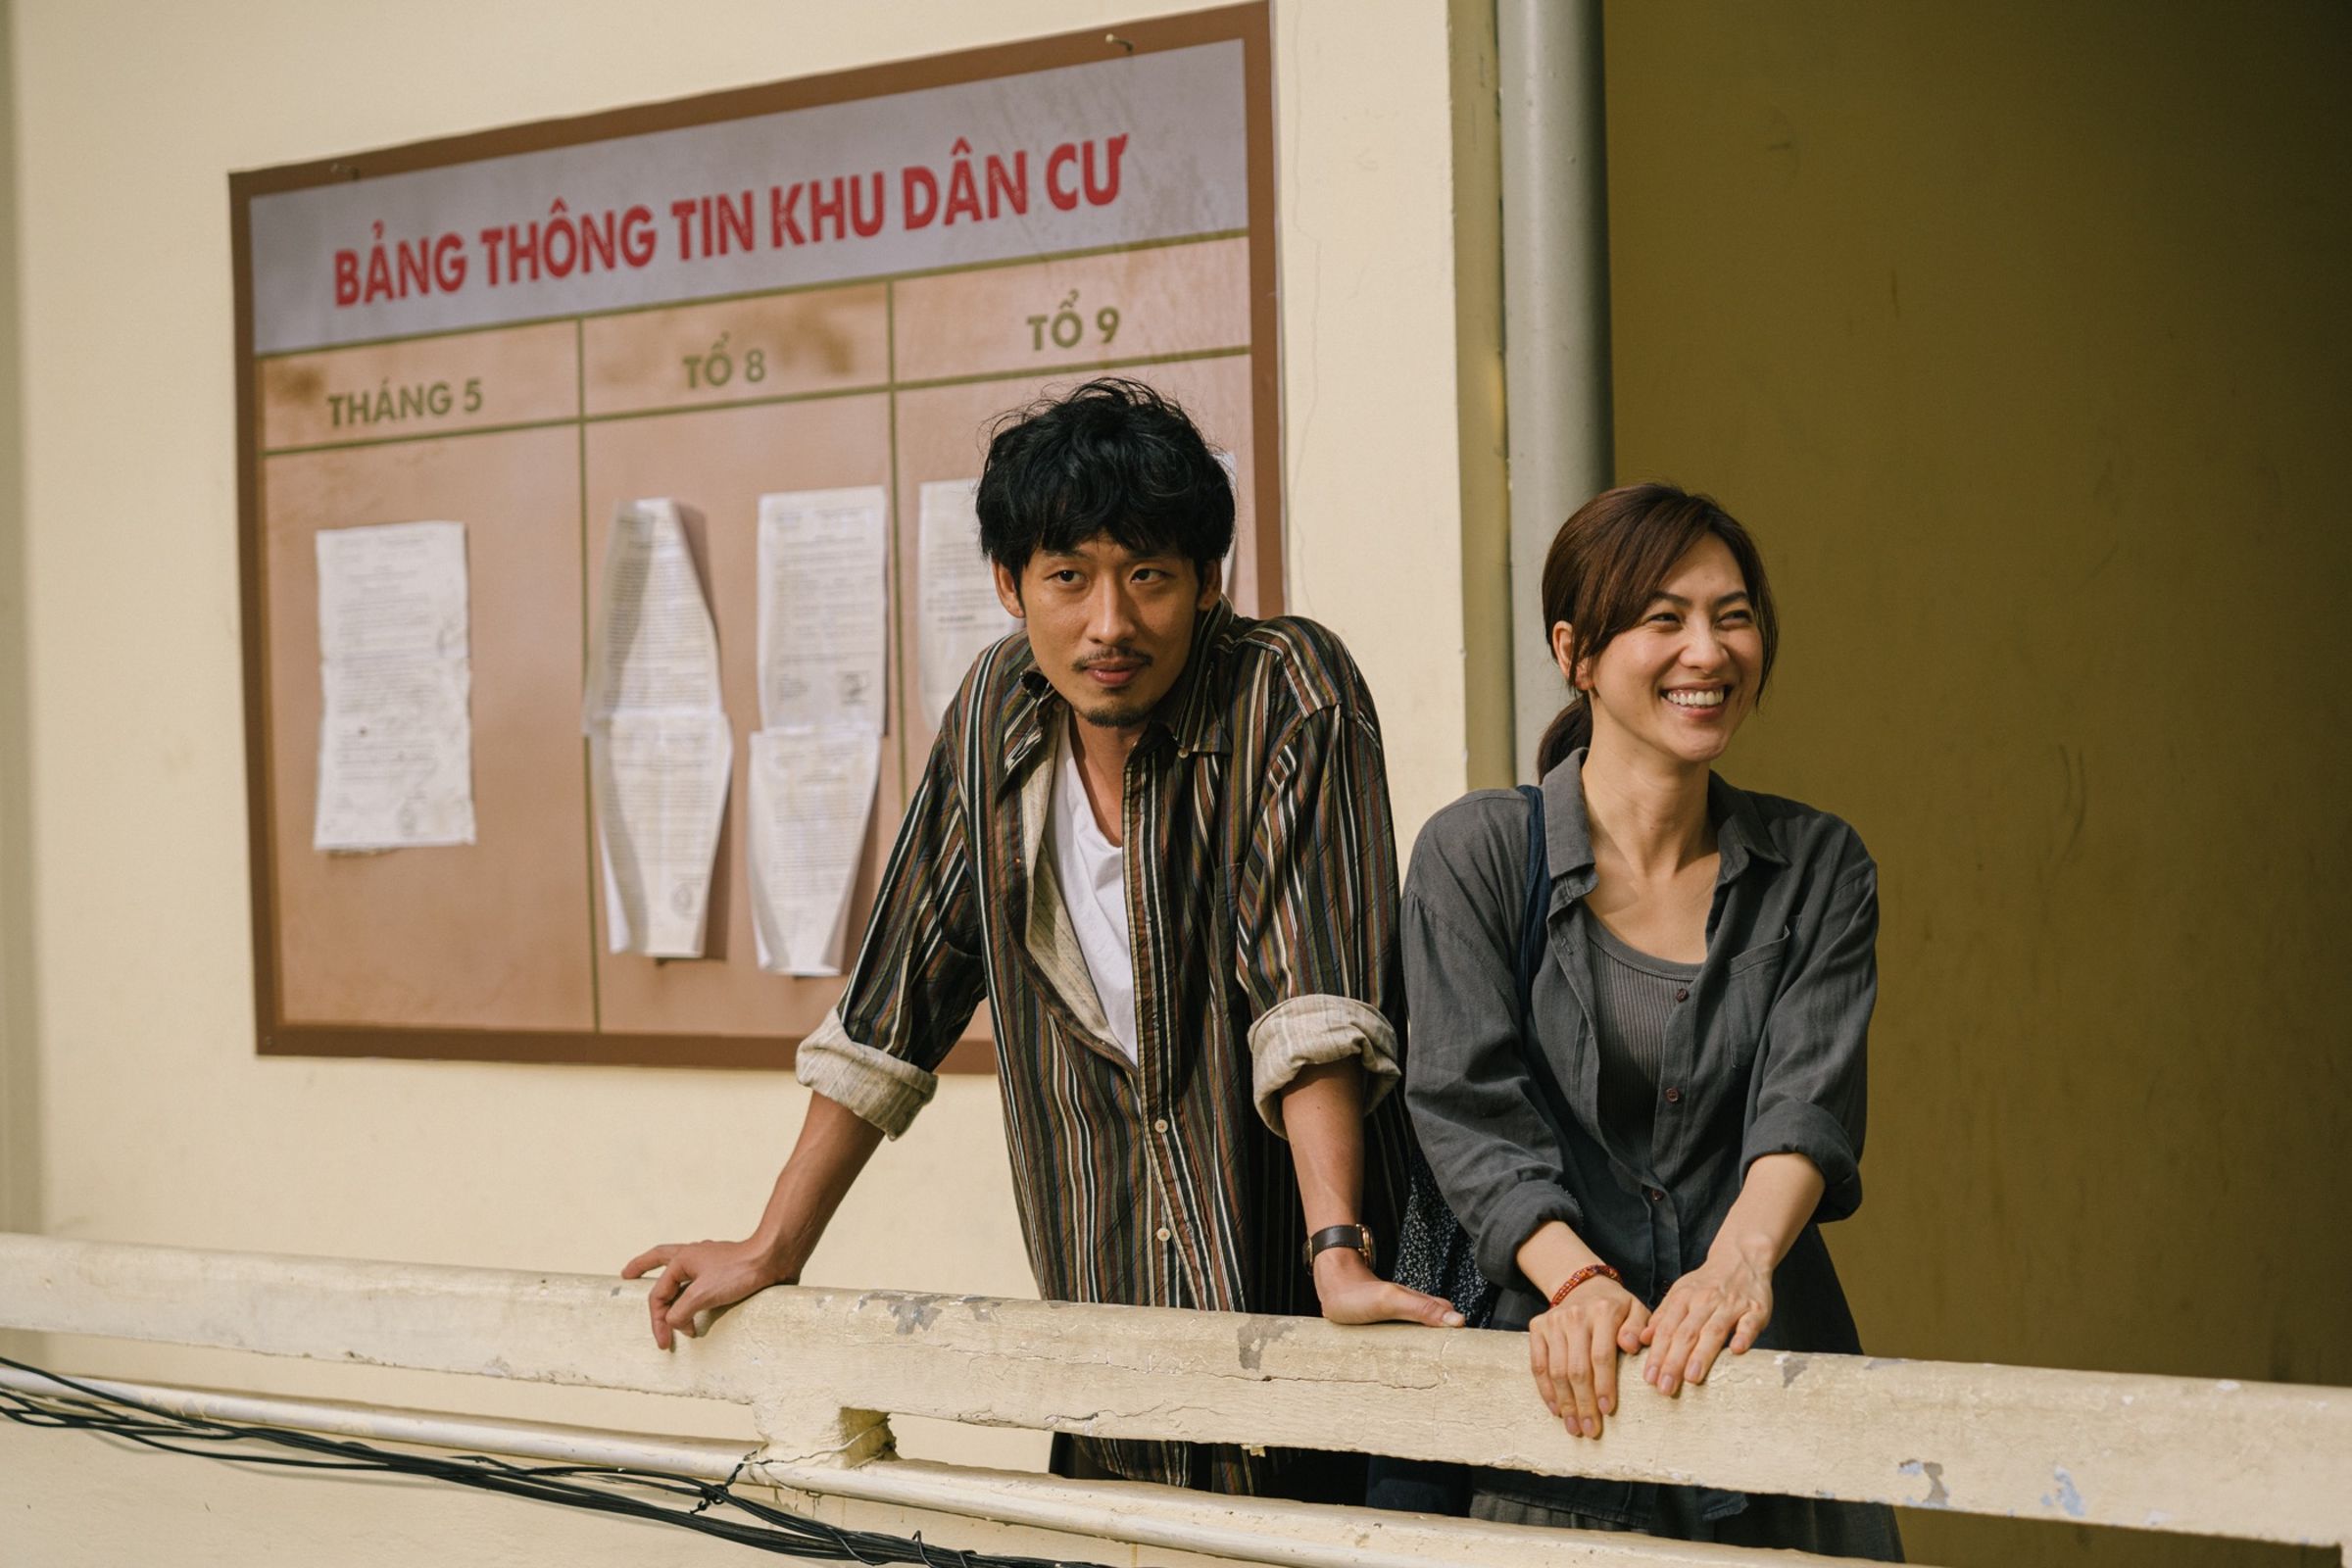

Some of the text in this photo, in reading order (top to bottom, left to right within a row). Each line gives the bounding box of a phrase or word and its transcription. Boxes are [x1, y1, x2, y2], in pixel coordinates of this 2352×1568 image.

[335, 133, 1129, 307] BẢNG THÔNG TIN KHU DÂN CƯ
[1026, 290, 1120, 351] TỔ 9
[682, 331, 765, 390] TỔ 8
[326, 378, 483, 428] THÁNG 5
